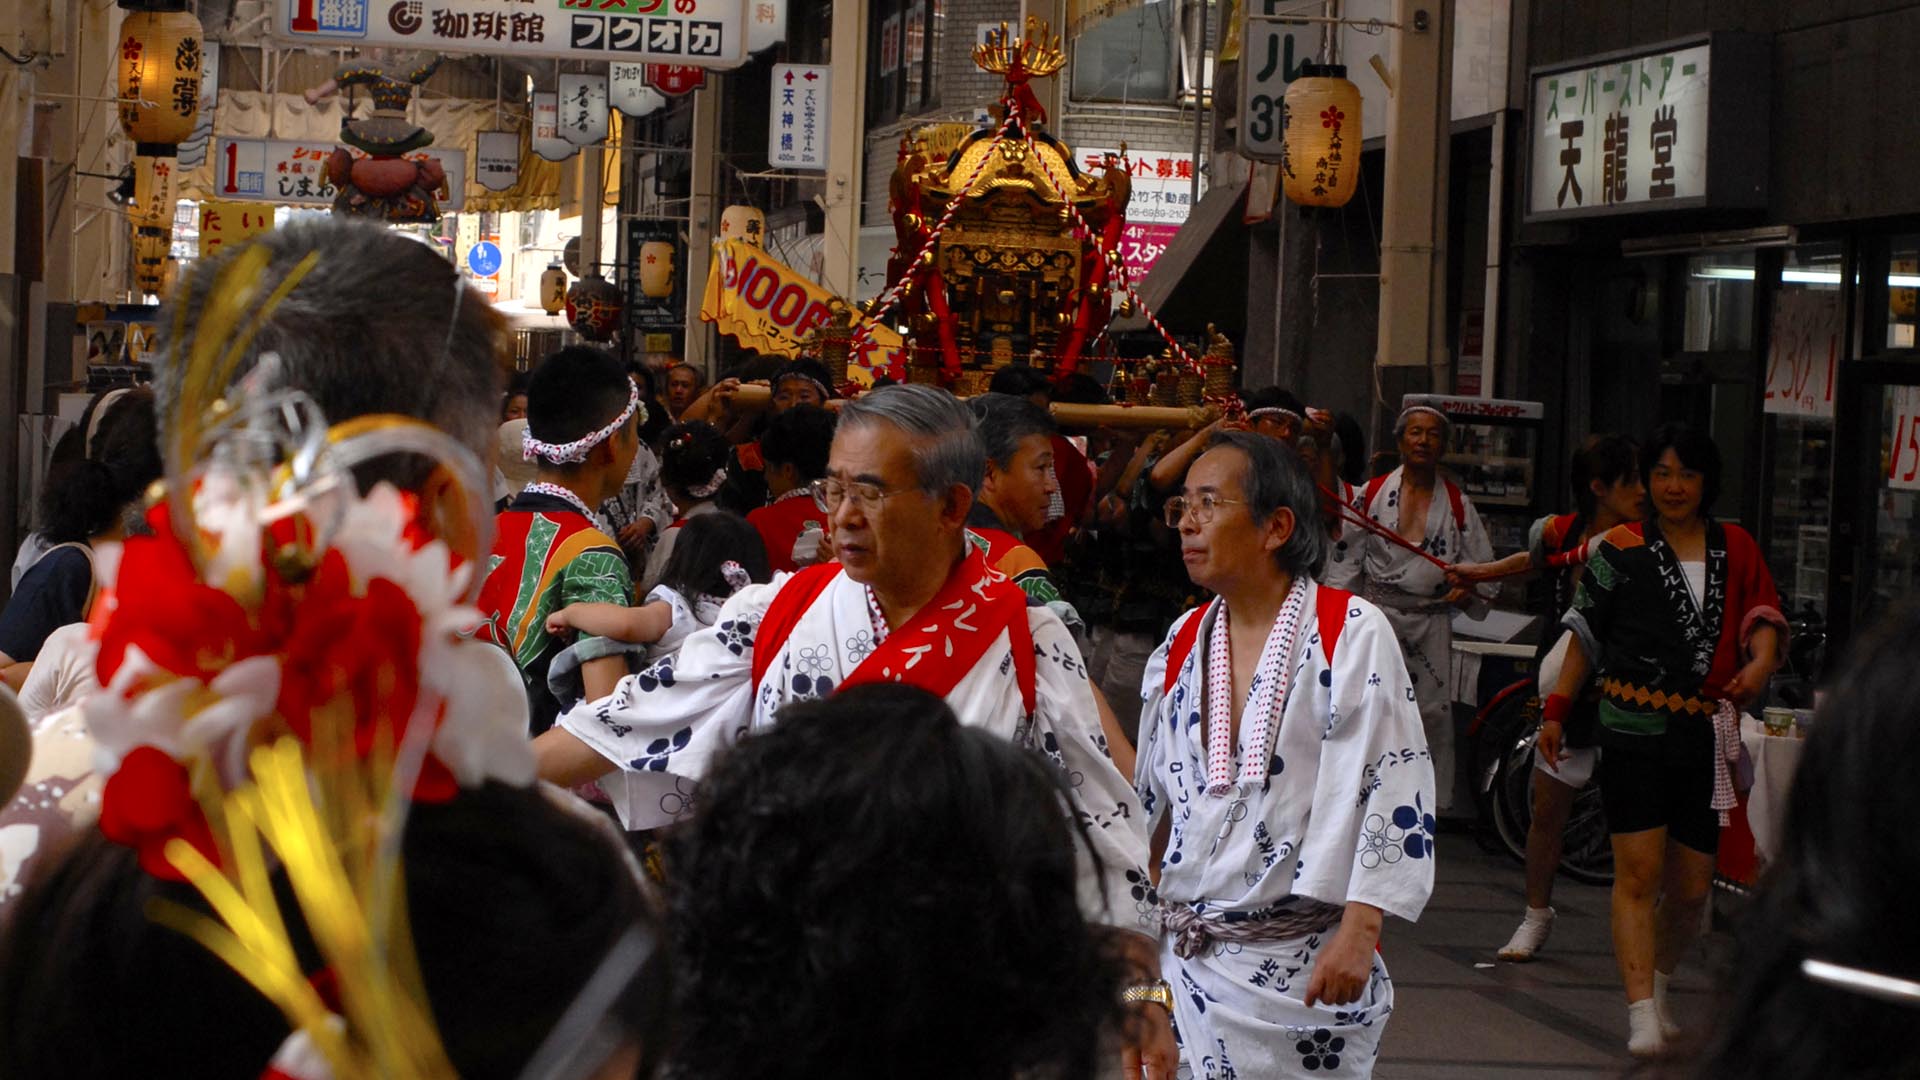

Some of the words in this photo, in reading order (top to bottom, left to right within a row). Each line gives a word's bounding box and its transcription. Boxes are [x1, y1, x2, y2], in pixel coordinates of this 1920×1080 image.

[432, 8, 545, 43] 珈琲館
[574, 16, 720, 53] フクオカ
[781, 89, 795, 151] 天神橋
[1557, 104, 1678, 209] 天龍堂
